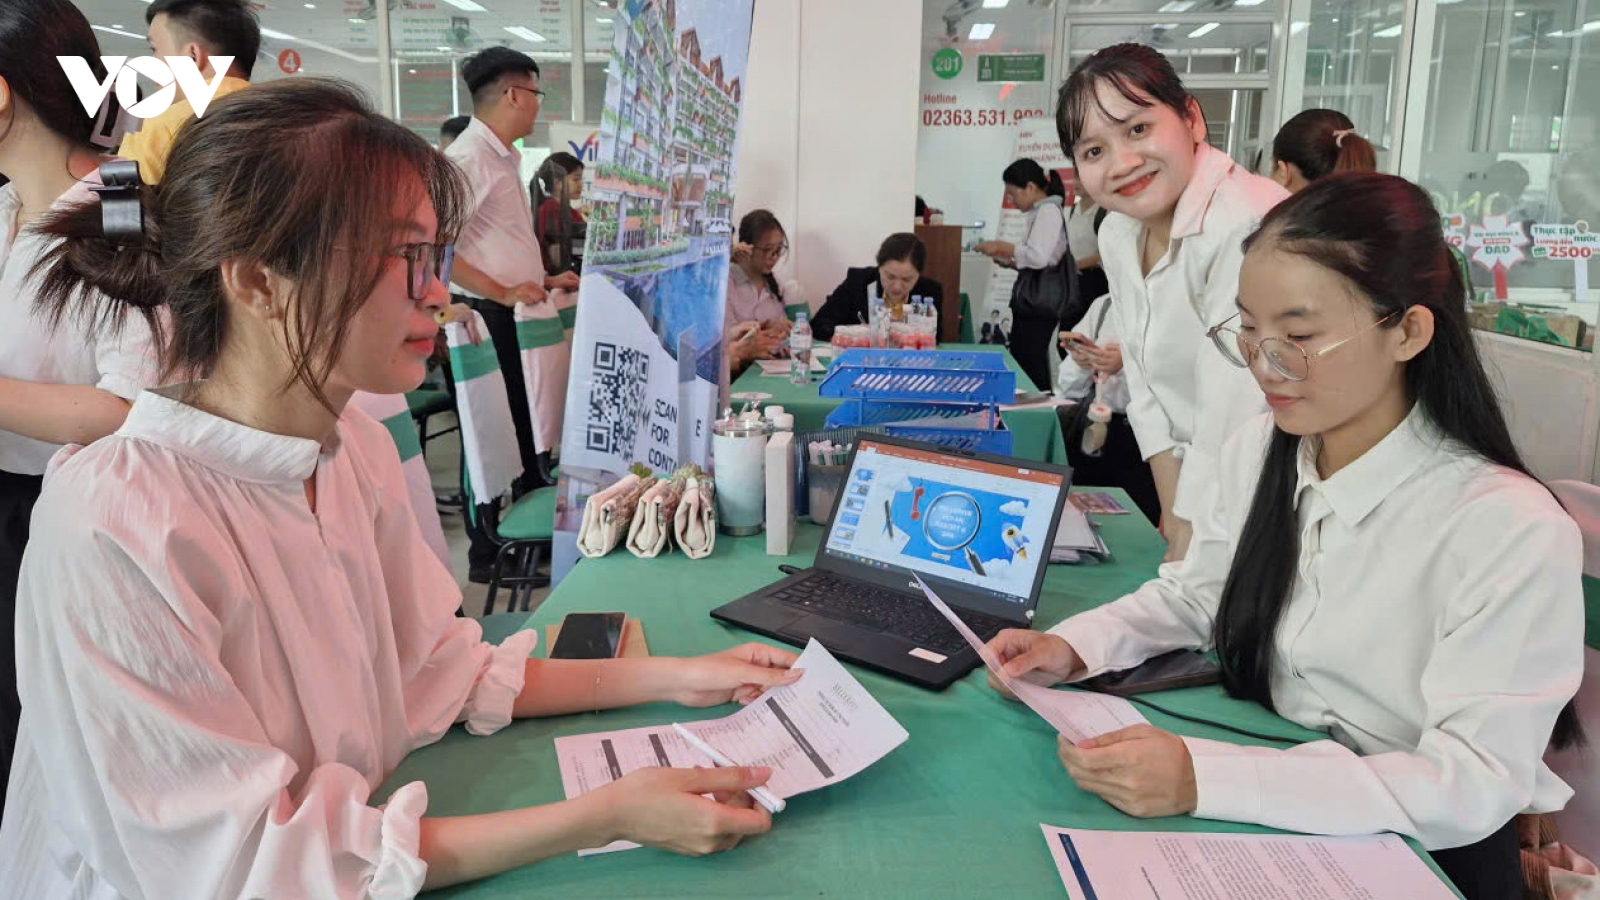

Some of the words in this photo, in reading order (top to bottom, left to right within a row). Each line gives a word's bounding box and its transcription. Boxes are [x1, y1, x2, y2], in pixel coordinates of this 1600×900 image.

[283, 51, 297, 71] 4
[935, 57, 958, 72] 201
[923, 93, 957, 104] Hotline
[1549, 246, 1591, 258] 2500
[654, 398, 677, 424] SCAN
[651, 422, 669, 447] FOR
